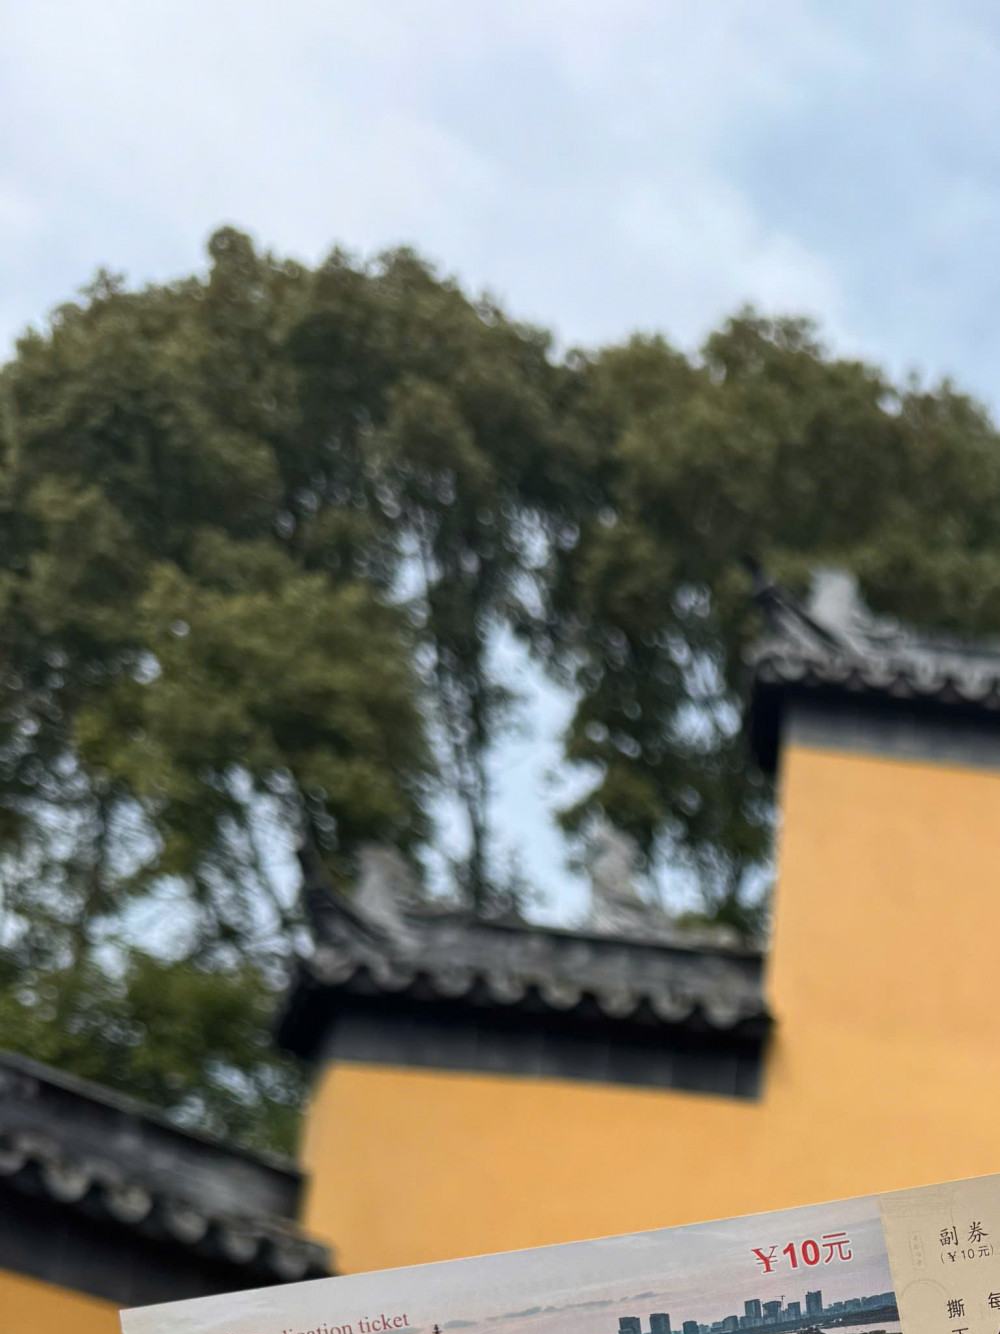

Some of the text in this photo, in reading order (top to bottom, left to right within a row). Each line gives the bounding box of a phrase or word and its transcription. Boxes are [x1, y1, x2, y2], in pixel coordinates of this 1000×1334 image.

[939, 1221, 989, 1246] 副券
[750, 1231, 852, 1273] ¥10元
[358, 1312, 410, 1334] ticket
